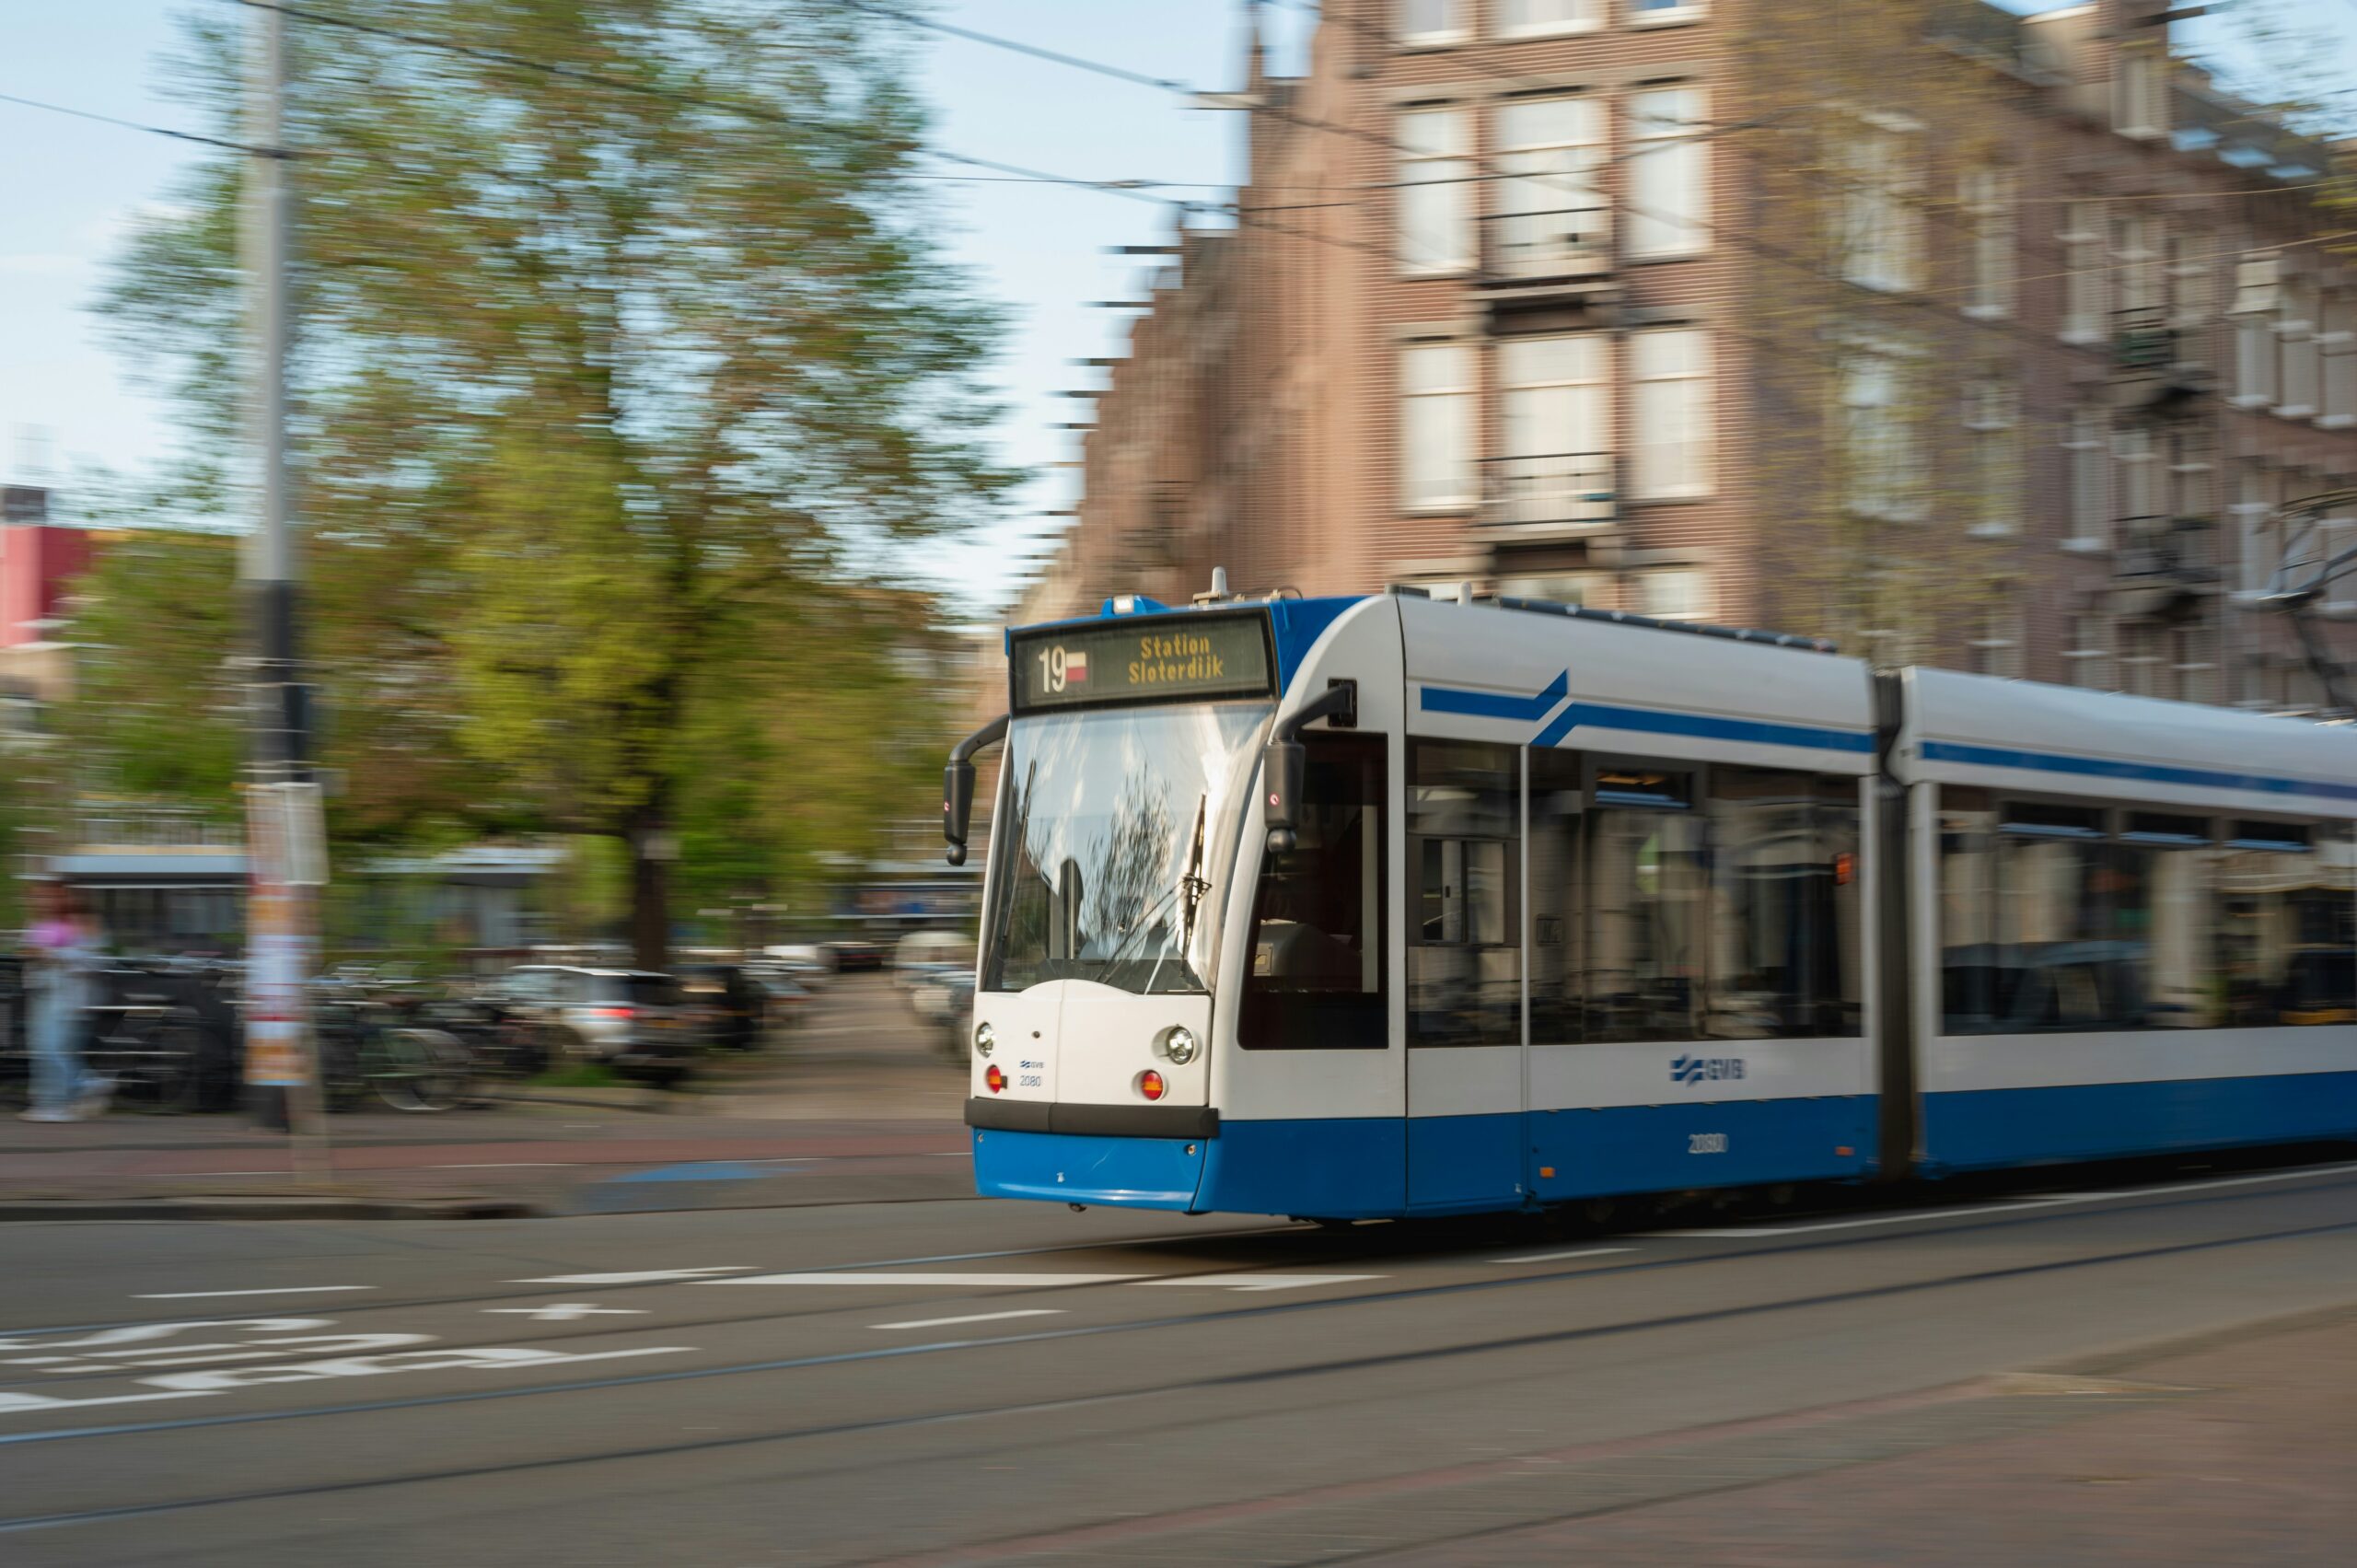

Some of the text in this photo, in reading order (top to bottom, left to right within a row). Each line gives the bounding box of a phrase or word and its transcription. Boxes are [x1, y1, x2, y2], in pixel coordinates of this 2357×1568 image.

[1141, 633, 1209, 658] Station
[1039, 645, 1066, 692] 19
[1129, 655, 1223, 684] Sloterdijk
[1019, 1074, 1041, 1086] 2080
